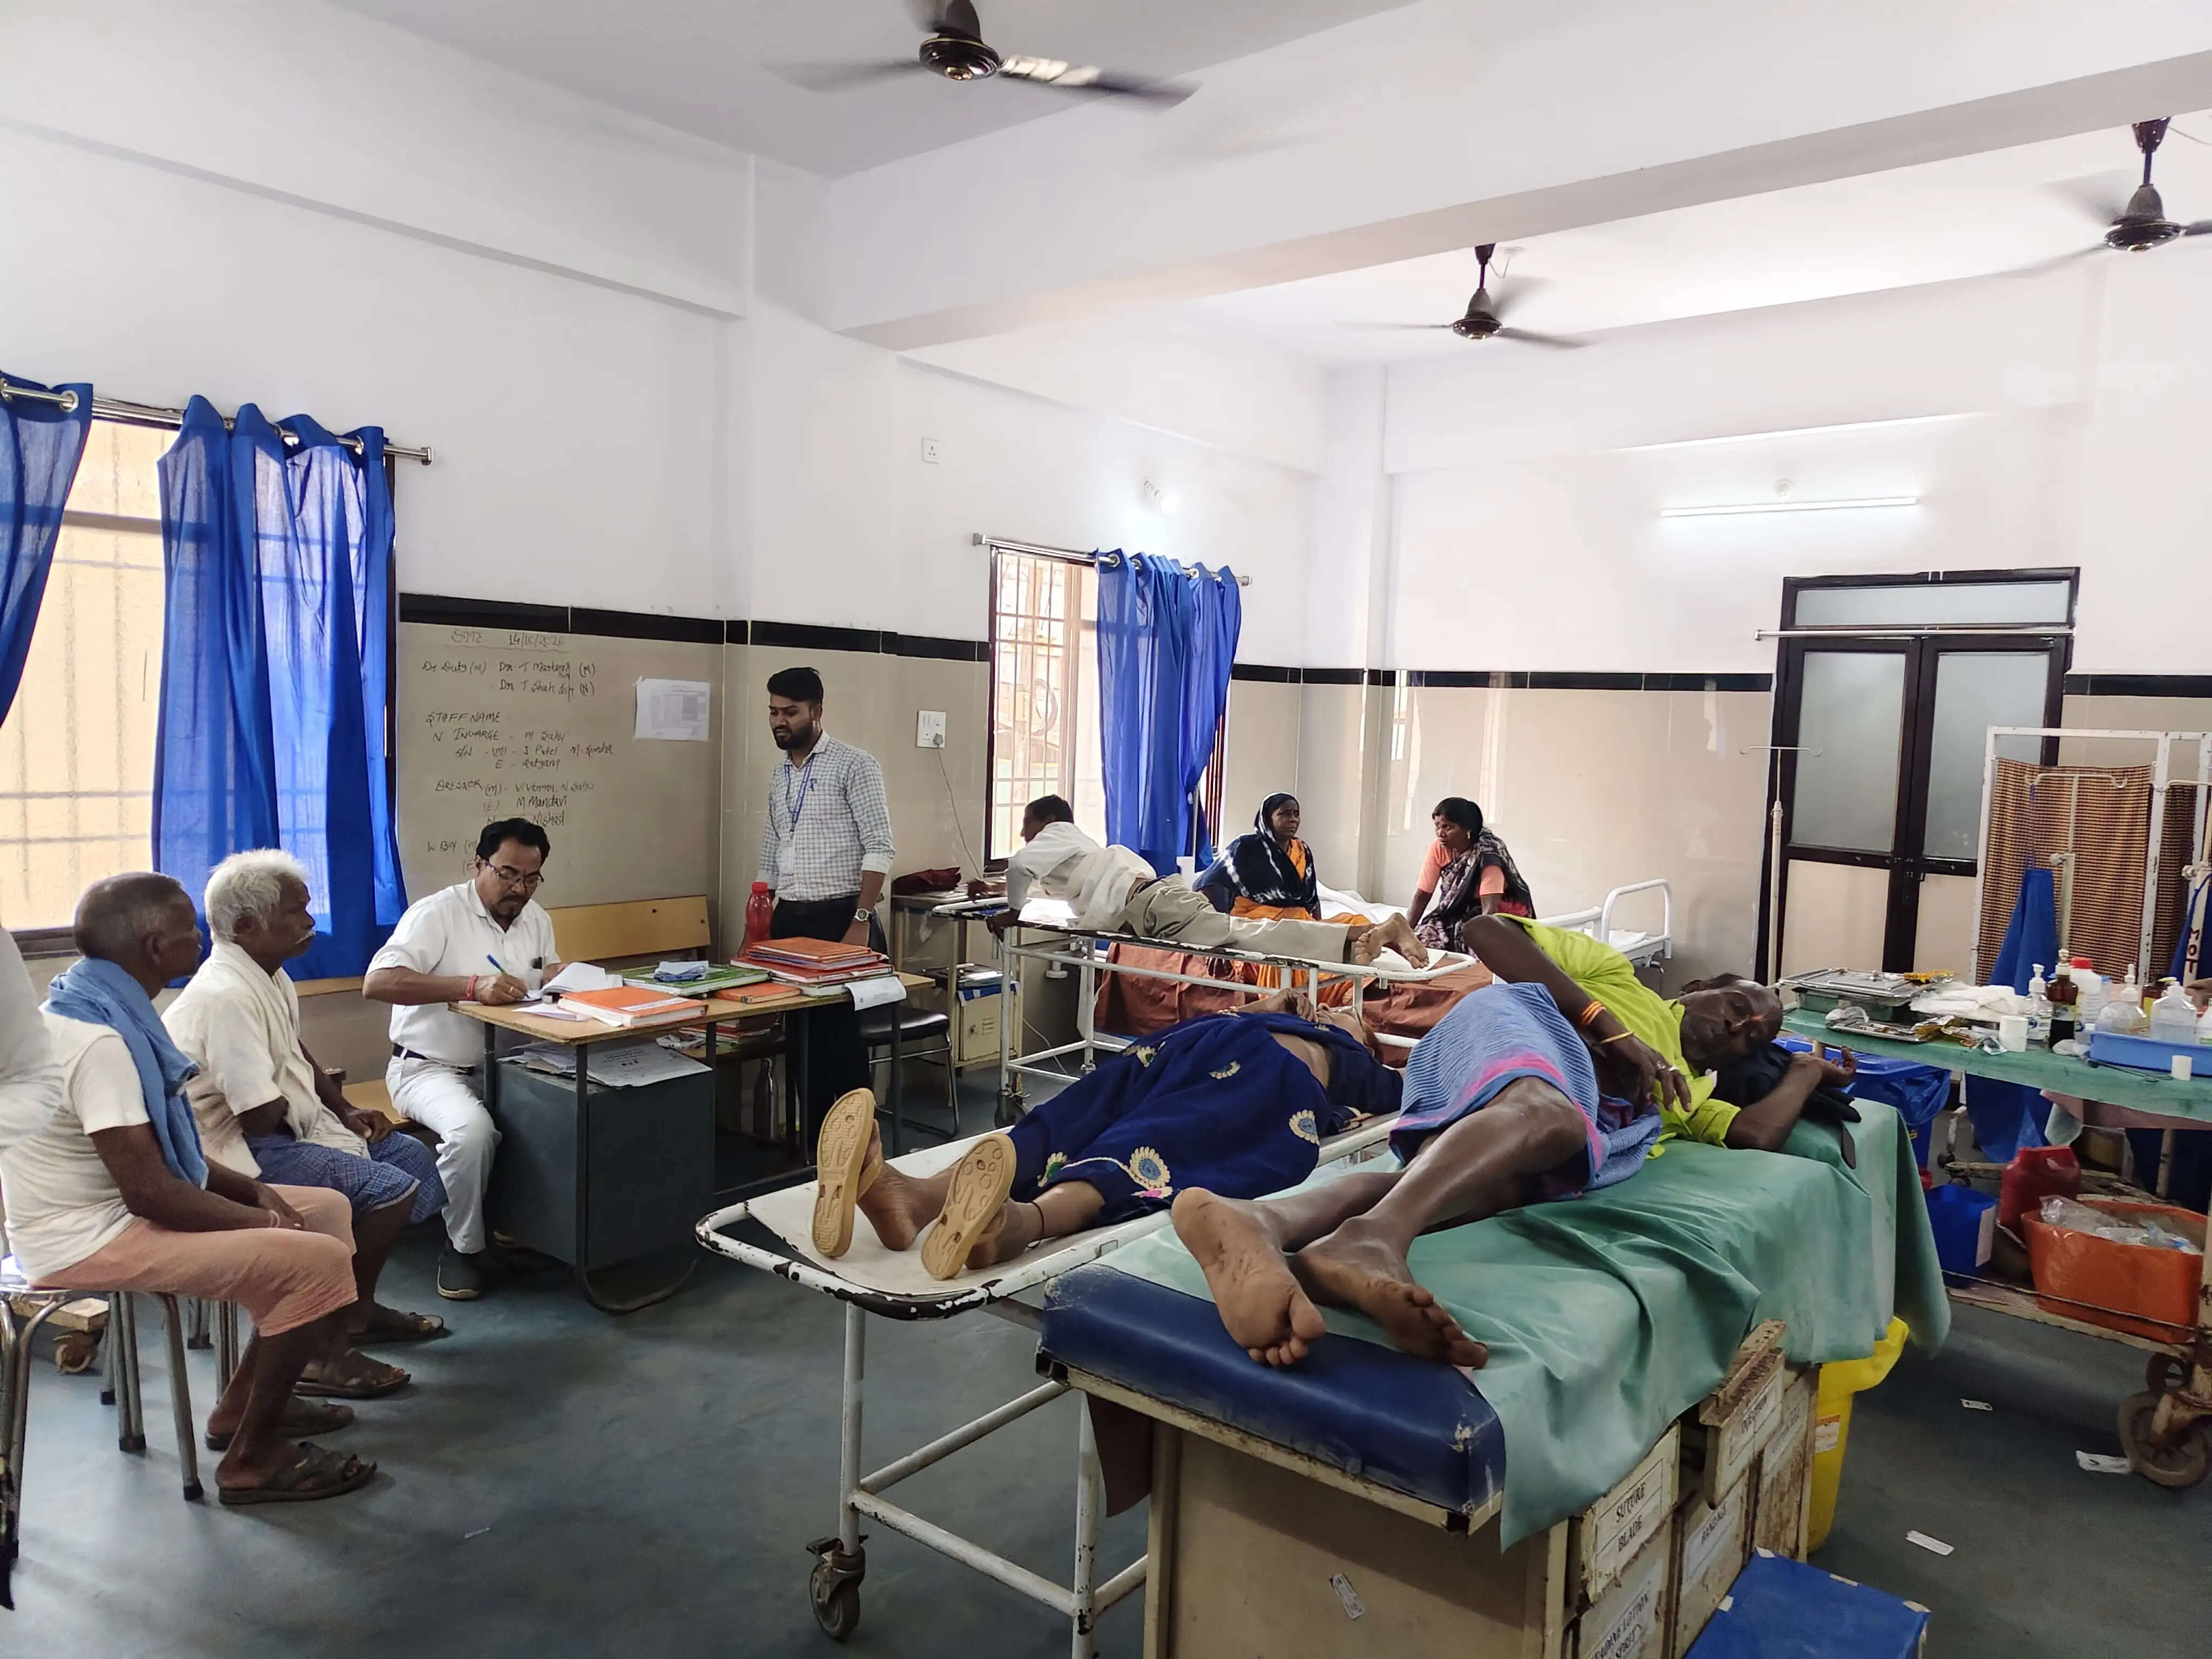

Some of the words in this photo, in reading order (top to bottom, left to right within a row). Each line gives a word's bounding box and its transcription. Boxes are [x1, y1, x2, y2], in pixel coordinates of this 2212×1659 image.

[426, 711, 469, 727] STAFF
[470, 711, 501, 723] NAME
[433, 731, 443, 742] N
[1616, 1481, 1646, 1523] SUTURE
[1618, 1514, 1642, 1553] BLADE
